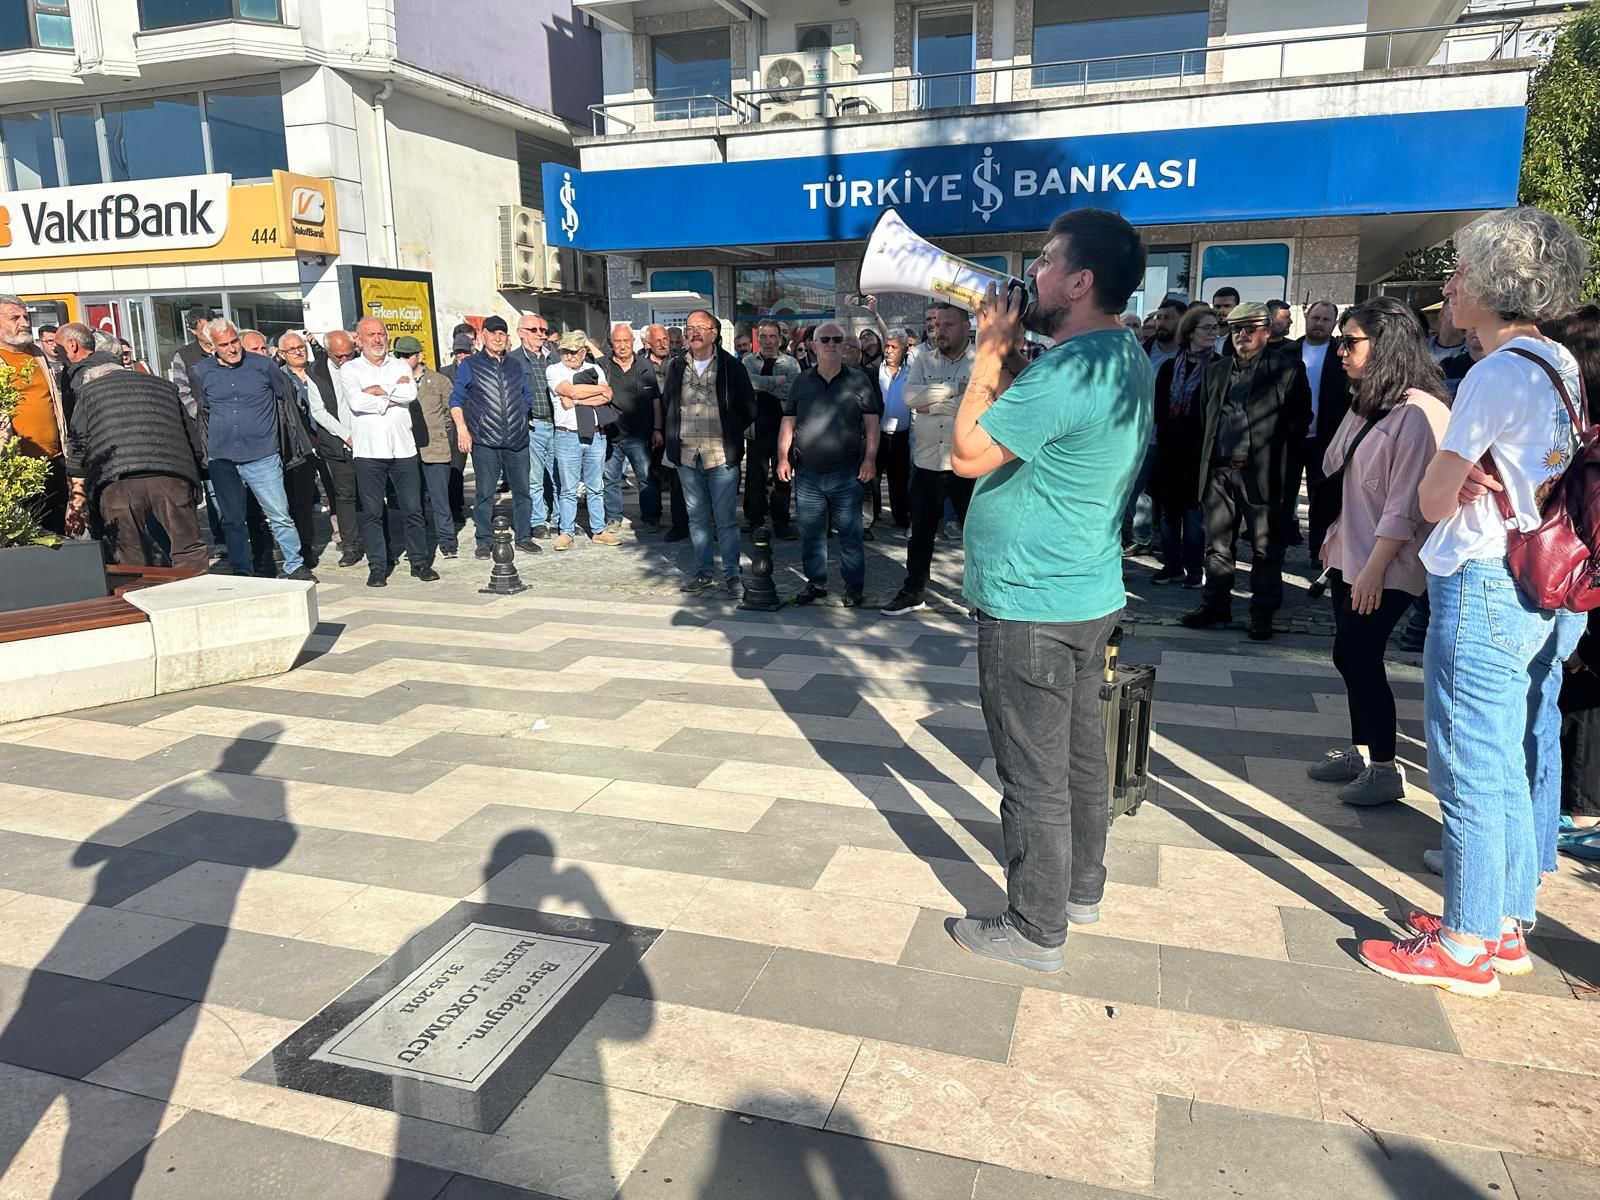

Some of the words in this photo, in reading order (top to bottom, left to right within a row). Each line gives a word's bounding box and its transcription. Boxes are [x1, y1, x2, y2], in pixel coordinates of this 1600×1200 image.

[803, 169, 962, 210] TÜRKİYE
[1013, 158, 1197, 197] BANKASI
[21, 189, 214, 245] VakıfBank
[251, 227, 277, 244] 444
[372, 306, 398, 319] Erken
[399, 307, 422, 322] Kayıt
[400, 322, 423, 333] Ediyor!
[479, 939, 537, 985] METİN
[399, 963, 465, 1014] 31.05.2011
[396, 984, 489, 1063] LOKUMCU
